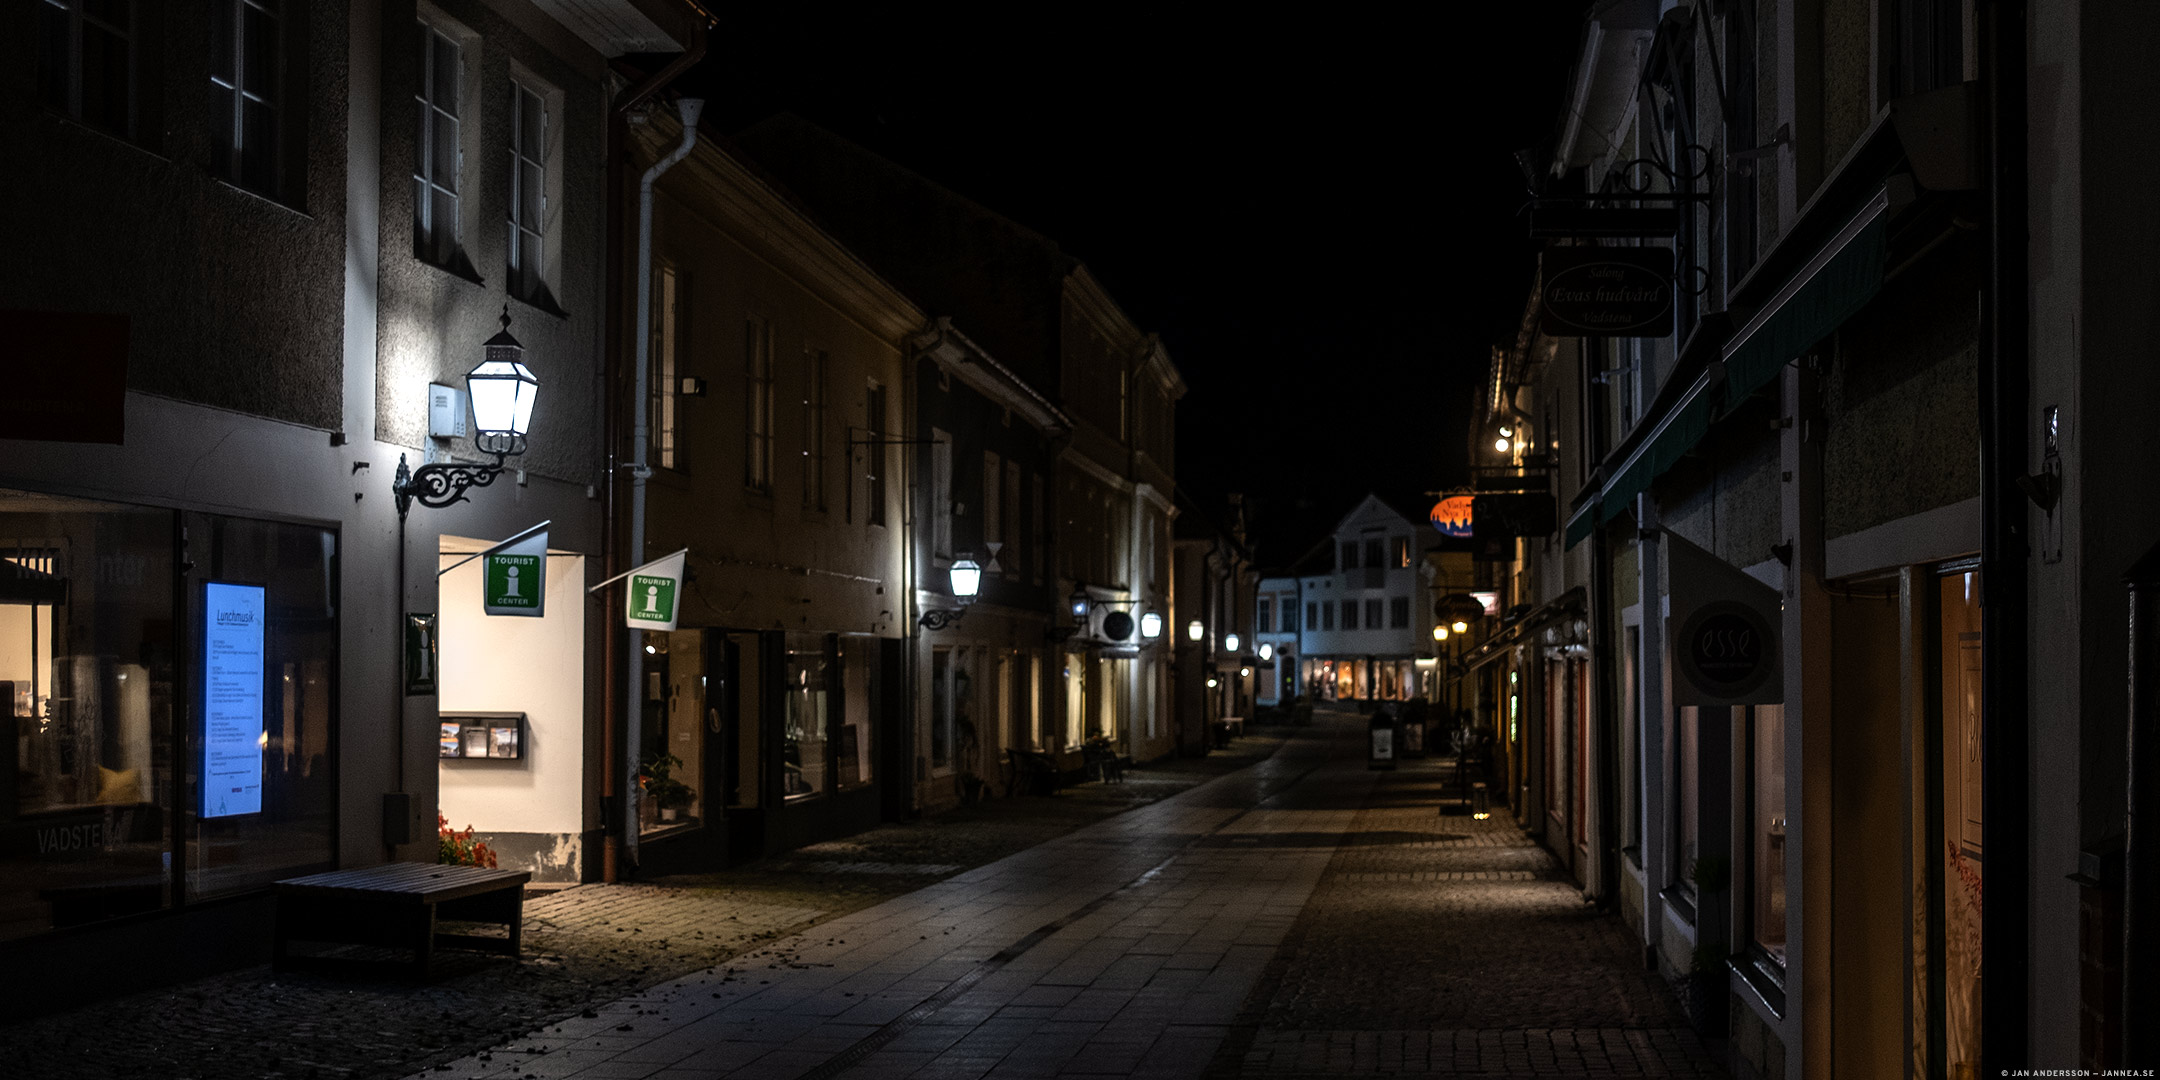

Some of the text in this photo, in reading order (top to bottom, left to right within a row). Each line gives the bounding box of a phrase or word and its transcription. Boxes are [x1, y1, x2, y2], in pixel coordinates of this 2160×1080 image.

[1588, 266, 1625, 282] Salong
[1551, 285, 1663, 303] Evas hudvård
[1582, 310, 1632, 324] Vadstena
[494, 556, 535, 566] TOURIST
[637, 577, 671, 586] TOURIST
[497, 597, 529, 606] CENTER
[216, 609, 255, 623] Lunchmusik
[637, 611, 664, 620] CENTER
[1701, 628, 1751, 658] esse
